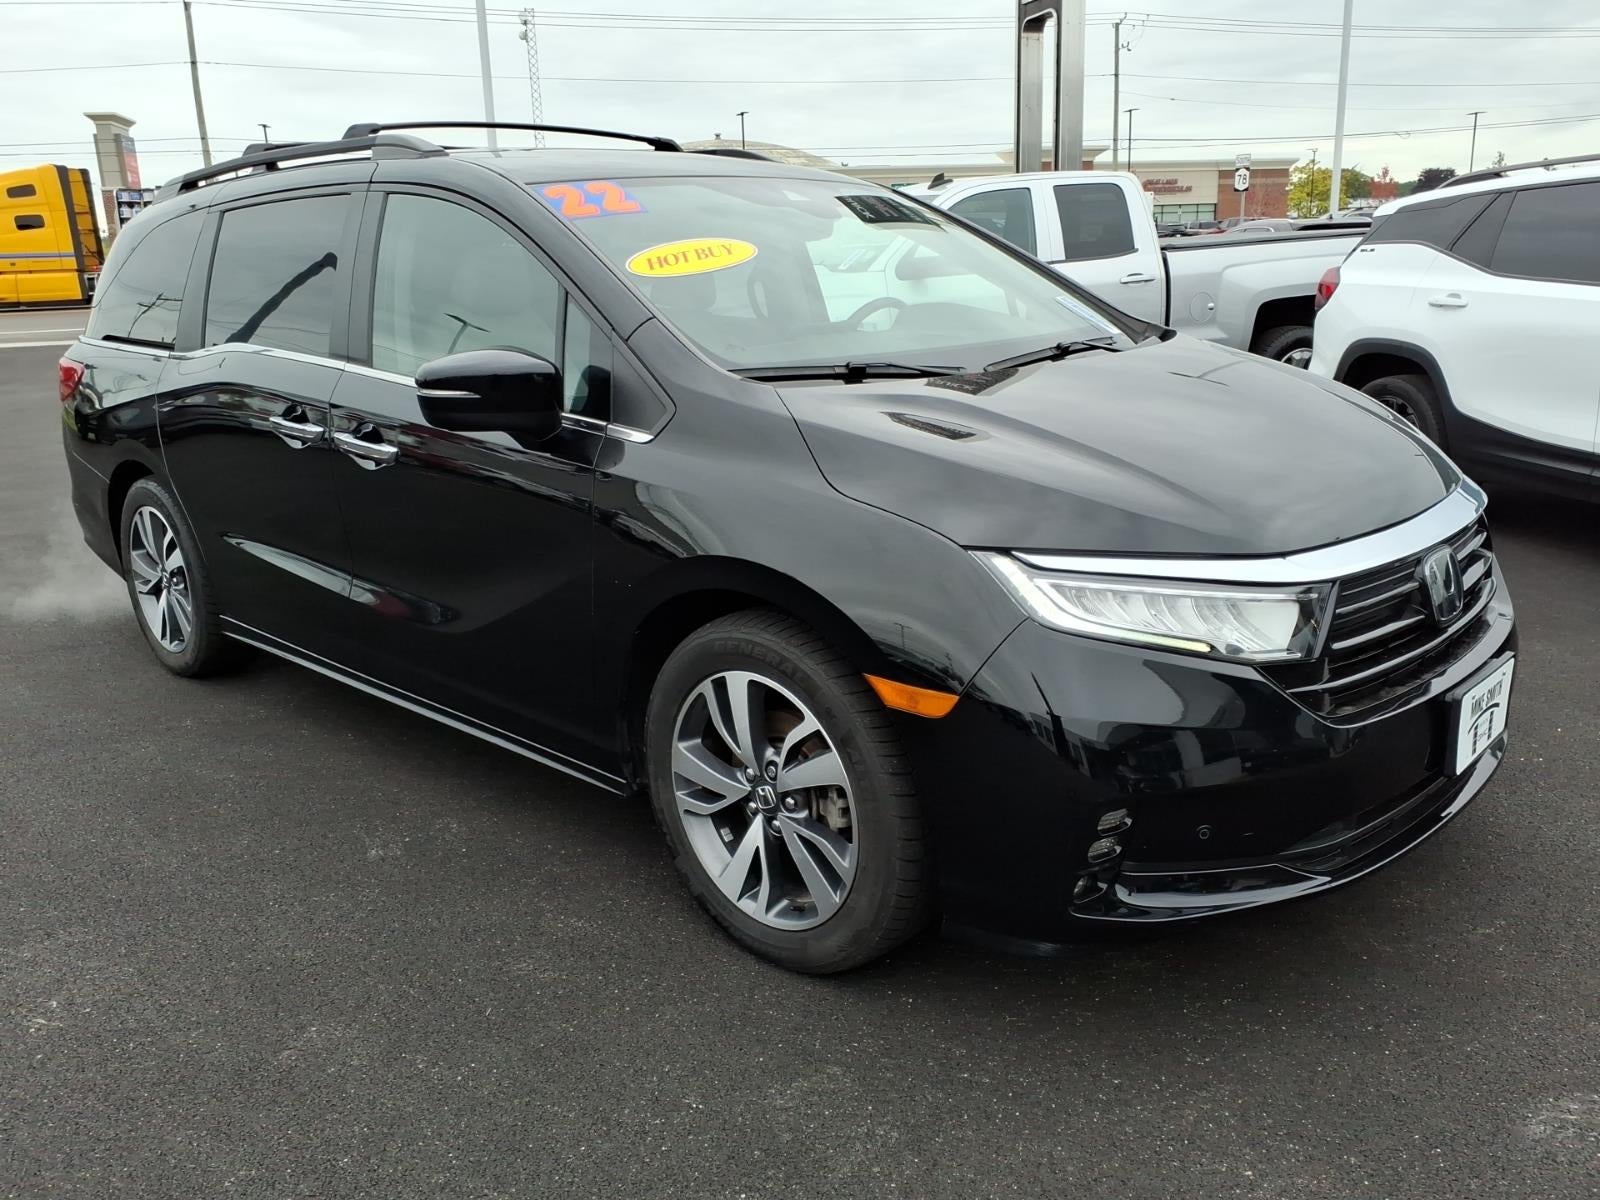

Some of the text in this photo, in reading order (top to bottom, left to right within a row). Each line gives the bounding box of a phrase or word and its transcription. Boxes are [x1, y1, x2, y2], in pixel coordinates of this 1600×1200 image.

[1237, 174, 1247, 185] 78
[544, 180, 641, 218] 22
[646, 243, 735, 271] HOT BUY
[1470, 679, 1503, 720] MIKE SMITH
